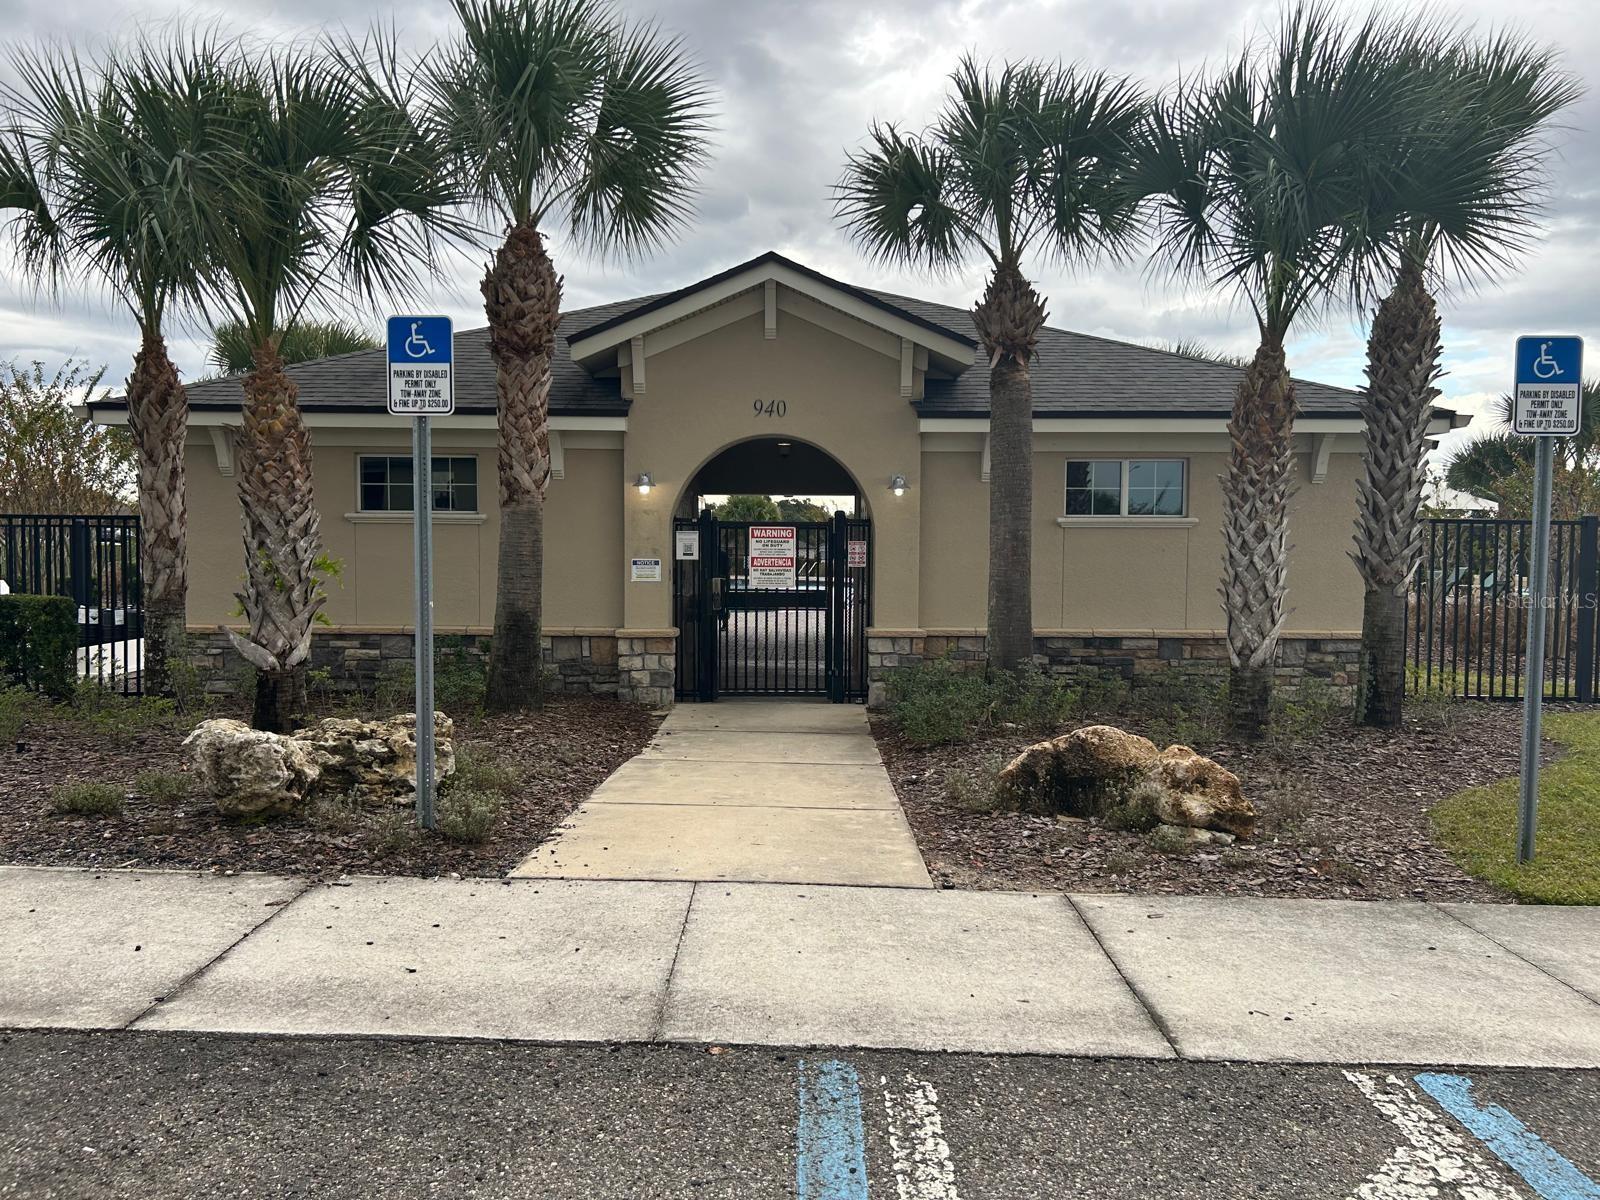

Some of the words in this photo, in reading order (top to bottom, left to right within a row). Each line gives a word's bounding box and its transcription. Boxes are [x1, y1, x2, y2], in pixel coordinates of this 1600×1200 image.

[393, 370, 414, 378] PARKING
[416, 370, 422, 378] BY
[424, 370, 448, 378] DISABLED
[404, 380, 423, 388] PERMIT
[424, 380, 436, 388] ONLY
[400, 390, 427, 398] TOW-AWAY
[428, 390, 442, 398] ZONE
[1520, 390, 1541, 398] PARKING
[1542, 390, 1549, 398] BY
[1550, 390, 1576, 398] DISABLED
[398, 400, 410, 408] FINE
[412, 400, 418, 408] UP
[419, 400, 426, 408] TO
[428, 400, 448, 408] $250.00
[1530, 400, 1550, 408] PERMIT
[1550, 400, 1564, 408] ONLY
[754, 399, 786, 418] 940
[1526, 410, 1553, 418] TOW-AWAY
[1554, 410, 1568, 418] ZONE
[1524, 420, 1535, 428] FINE
[1536, 420, 1544, 428] UP
[1544, 420, 1552, 428] TO
[1552, 420, 1574, 428] $250.00
[754, 530, 792, 538] WARNING
[753, 558, 792, 566] ADVERTENCIA
